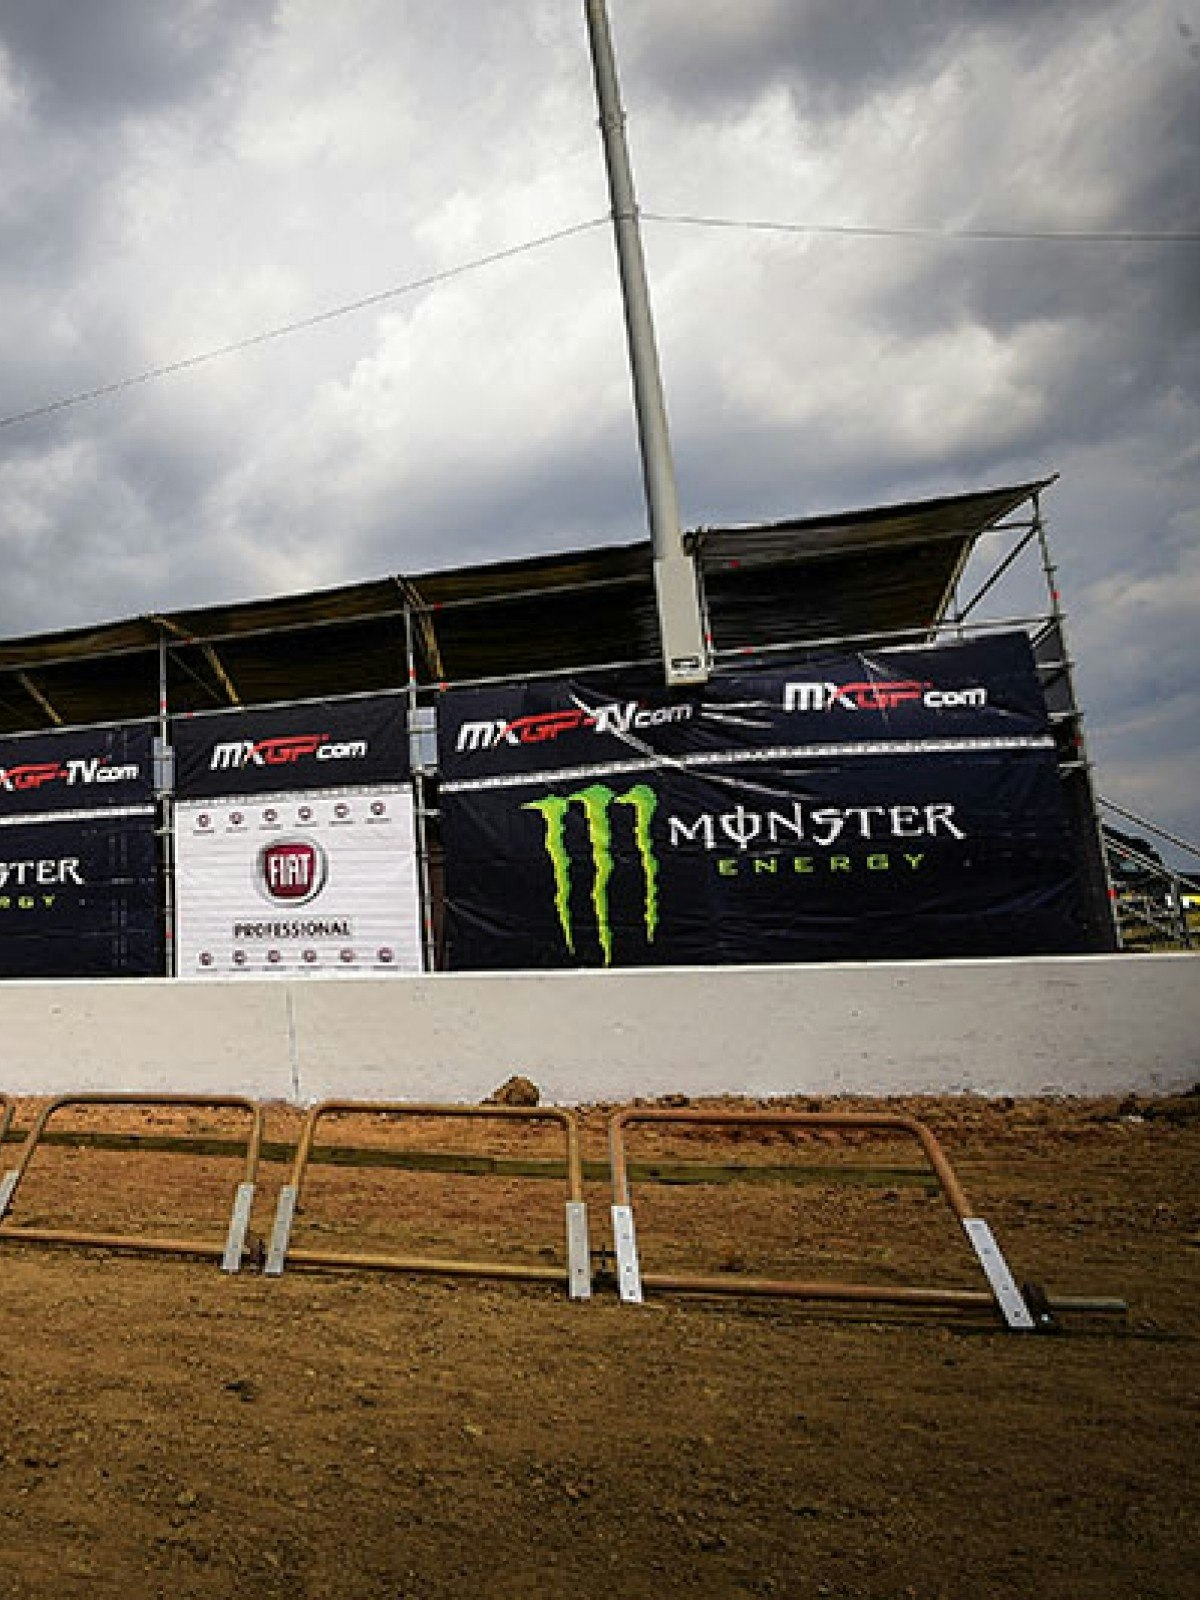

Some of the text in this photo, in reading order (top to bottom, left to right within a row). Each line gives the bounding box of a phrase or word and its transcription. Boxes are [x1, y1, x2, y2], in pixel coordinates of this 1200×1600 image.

[668, 803, 966, 849] MONSTER
[270, 853, 312, 886] FIAT
[717, 853, 924, 875] ENERGY
[234, 920, 351, 938] PROFESSIONAL
